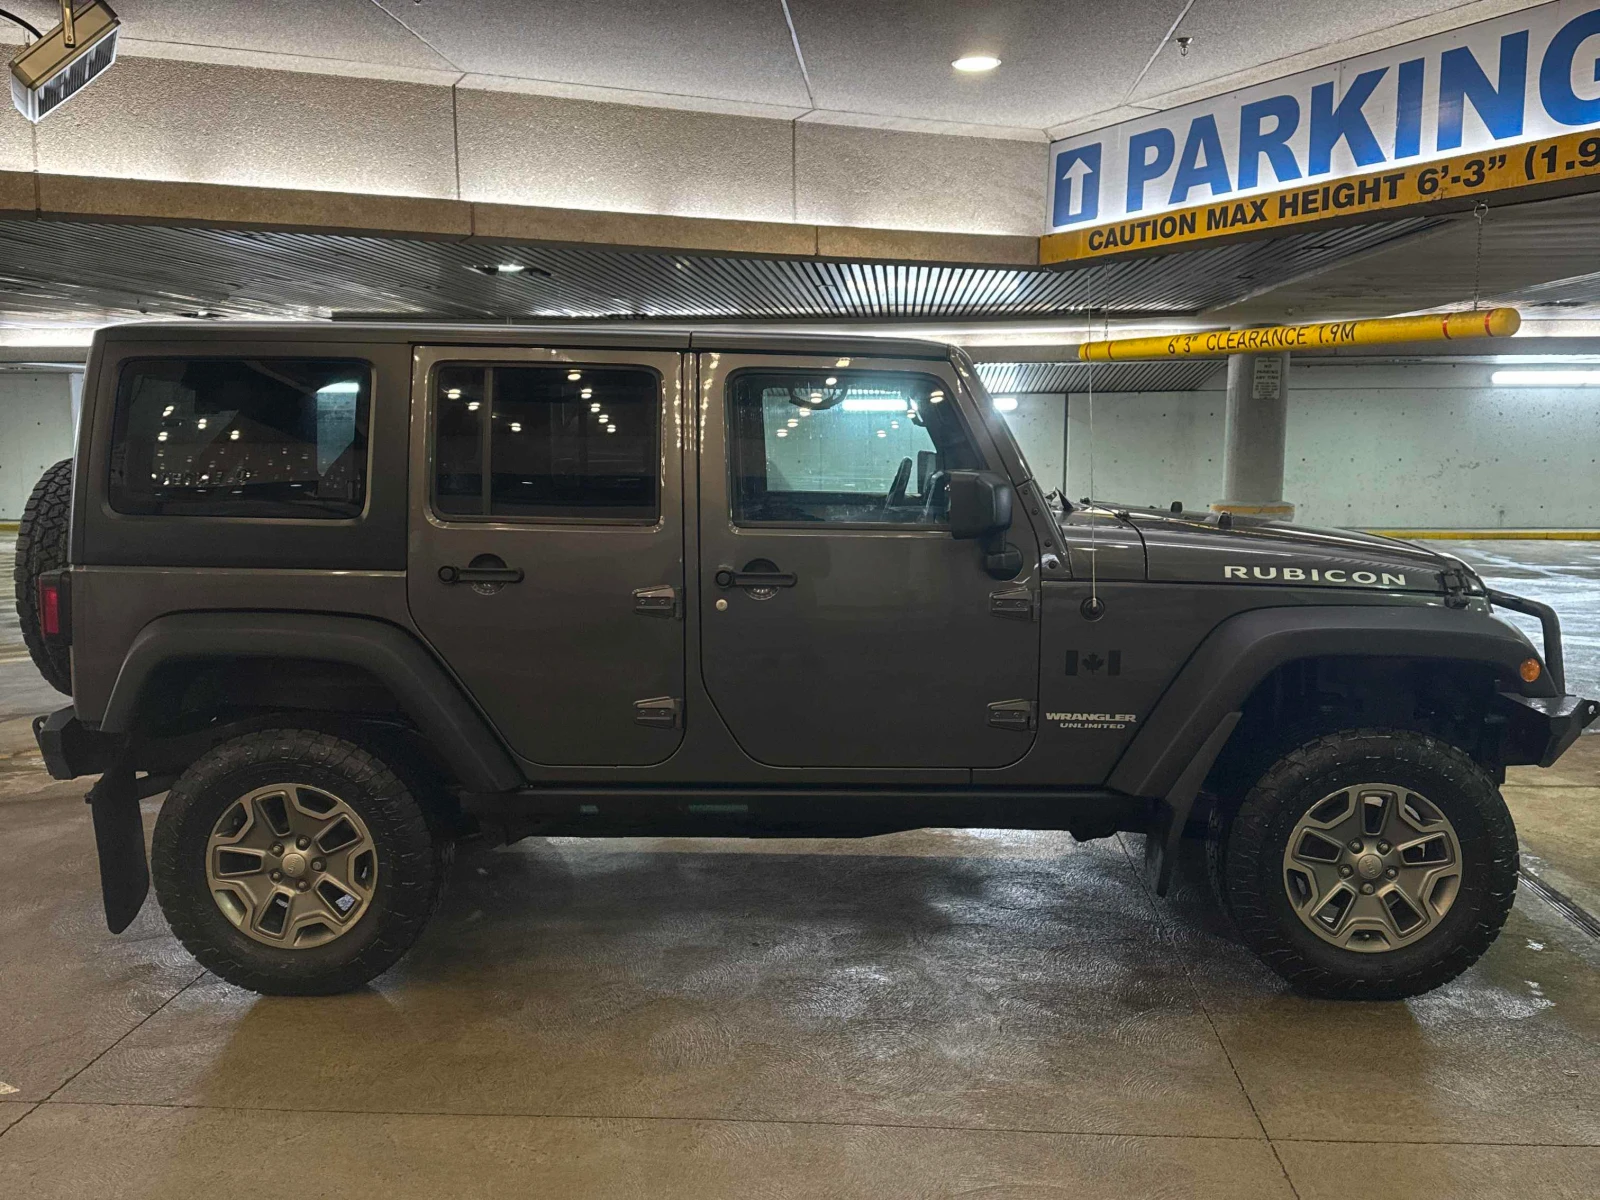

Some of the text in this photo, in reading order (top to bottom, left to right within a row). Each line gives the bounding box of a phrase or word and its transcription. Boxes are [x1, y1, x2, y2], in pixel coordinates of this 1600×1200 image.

[1126, 8, 1600, 213] PARKING
[1088, 213, 1196, 251] CAUTION
[1207, 199, 1268, 231] MAX
[1279, 173, 1405, 218] HEIGHT
[1206, 326, 1309, 351] CLEARANCE
[1318, 323, 1357, 344] 1.9M
[1224, 565, 1406, 586] RUBICON
[1045, 712, 1137, 722] WRANGLER
